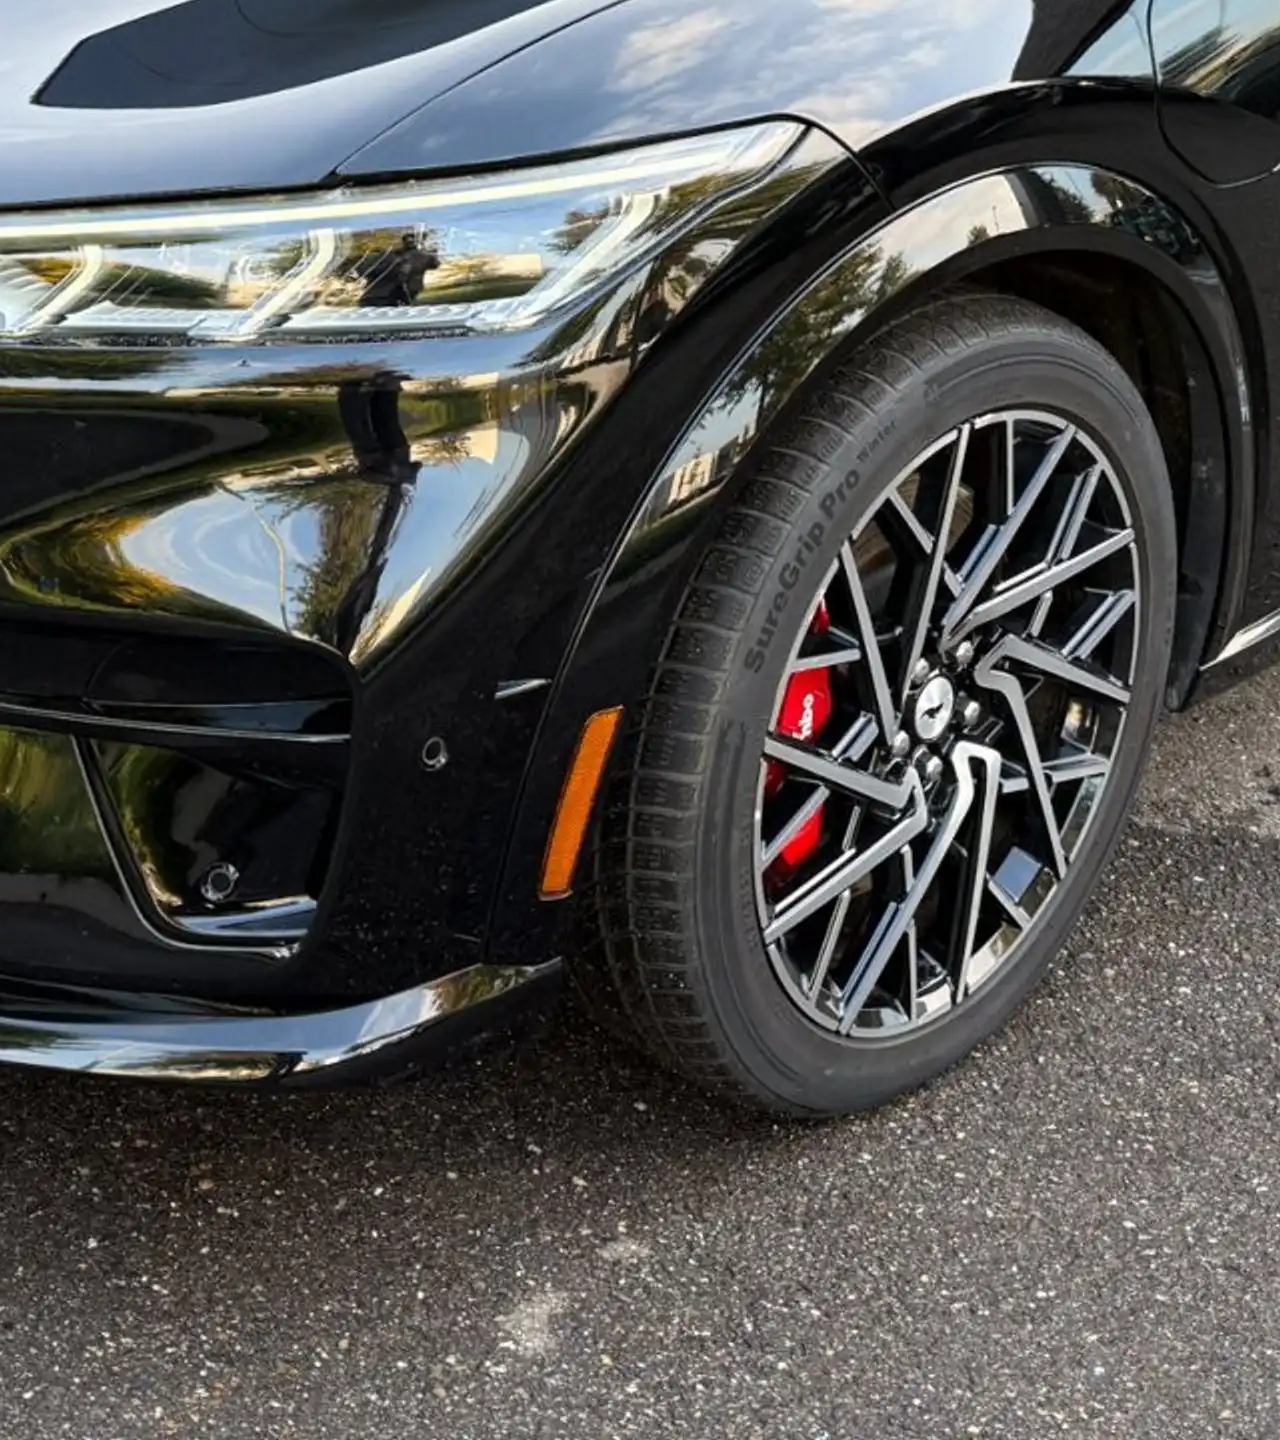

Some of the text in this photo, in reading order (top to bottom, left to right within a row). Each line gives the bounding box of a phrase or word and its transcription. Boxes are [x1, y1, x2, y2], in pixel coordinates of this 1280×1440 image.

[744, 419, 898, 674] SureGrip Pro Winter
